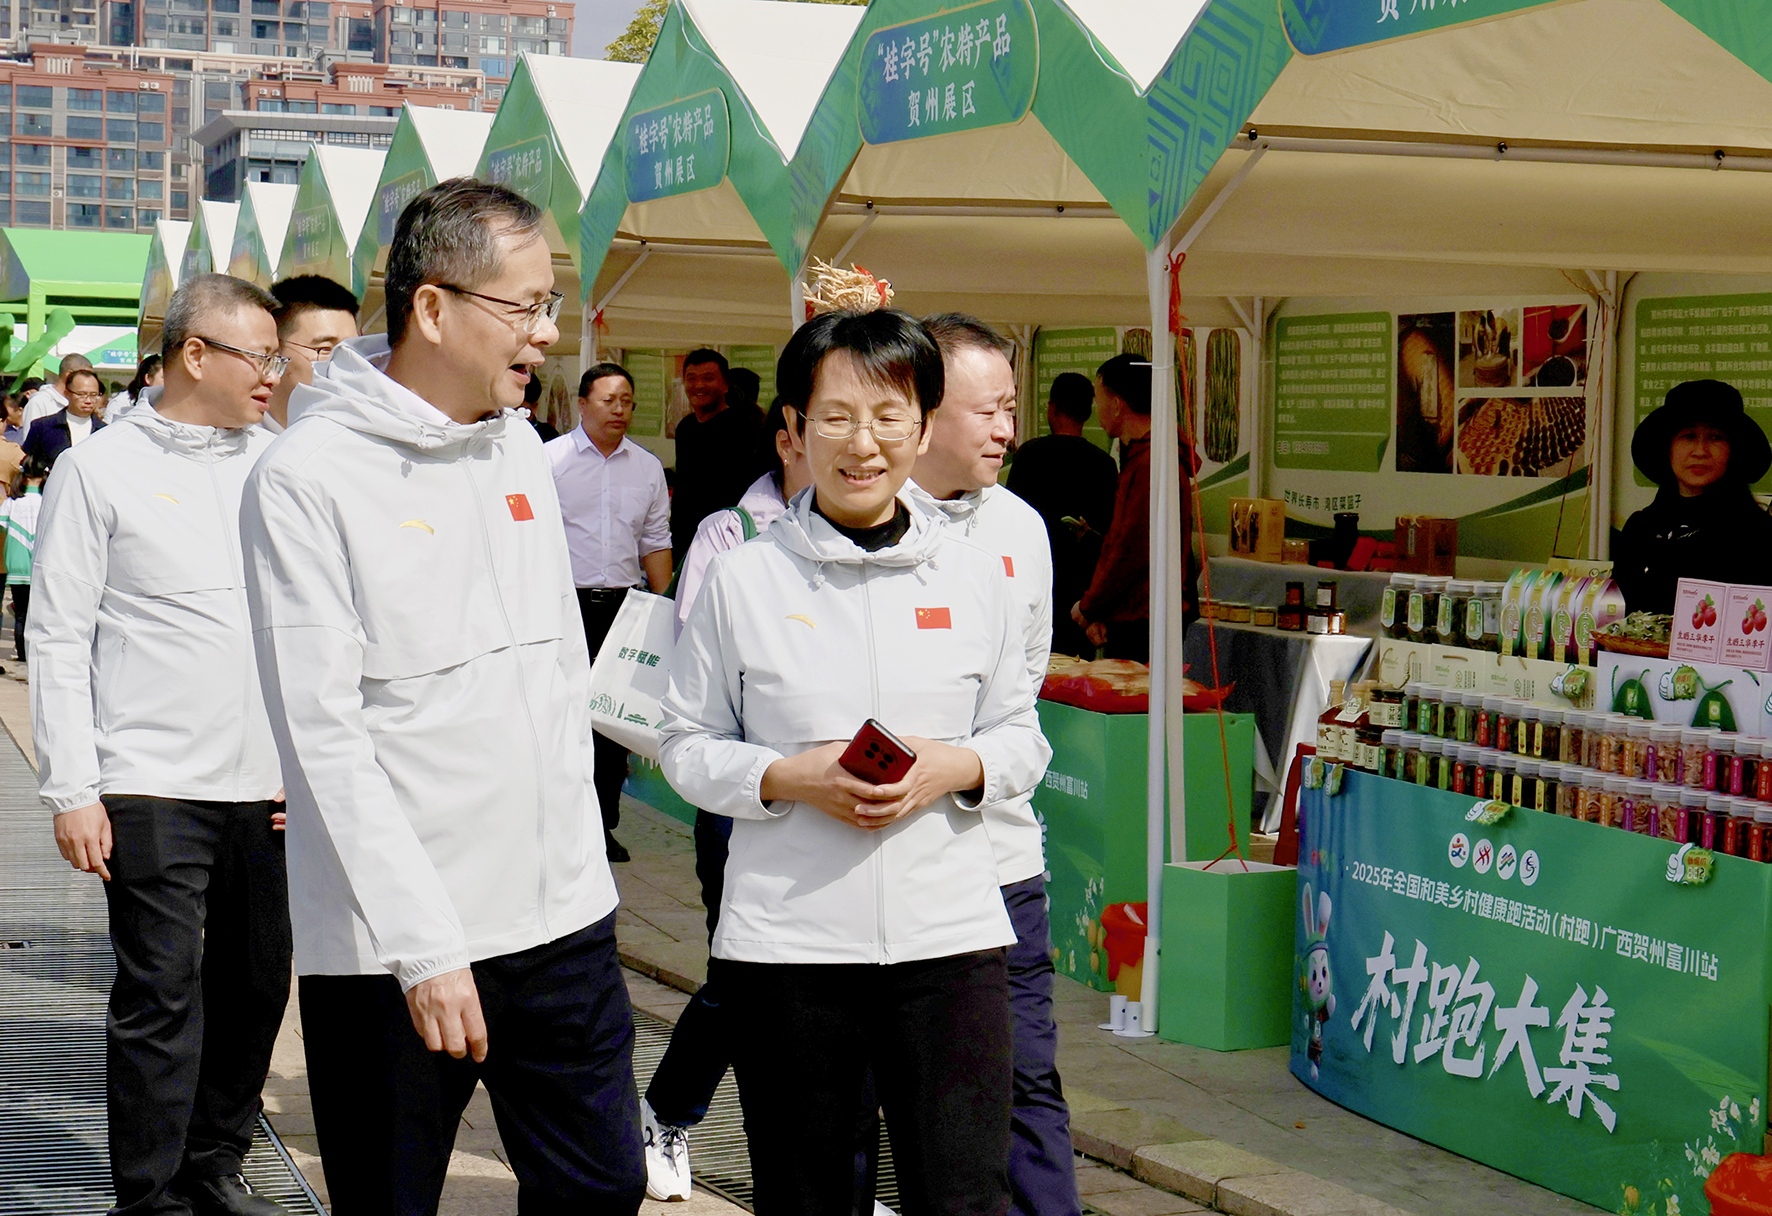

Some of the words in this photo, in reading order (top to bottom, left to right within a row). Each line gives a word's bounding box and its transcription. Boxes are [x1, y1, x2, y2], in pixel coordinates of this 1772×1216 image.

[878, 13, 1011, 83] “桂字号”农特产品
[907, 80, 976, 127] 贺州展区
[635, 104, 714, 155] “桂字号”农特产品
[654, 154, 695, 189] 贺州展区
[618, 646, 661, 667] 数字赋能
[1045, 770, 1088, 799] 西贺州富川站
[1351, 930, 1620, 1132] 村跑大集
